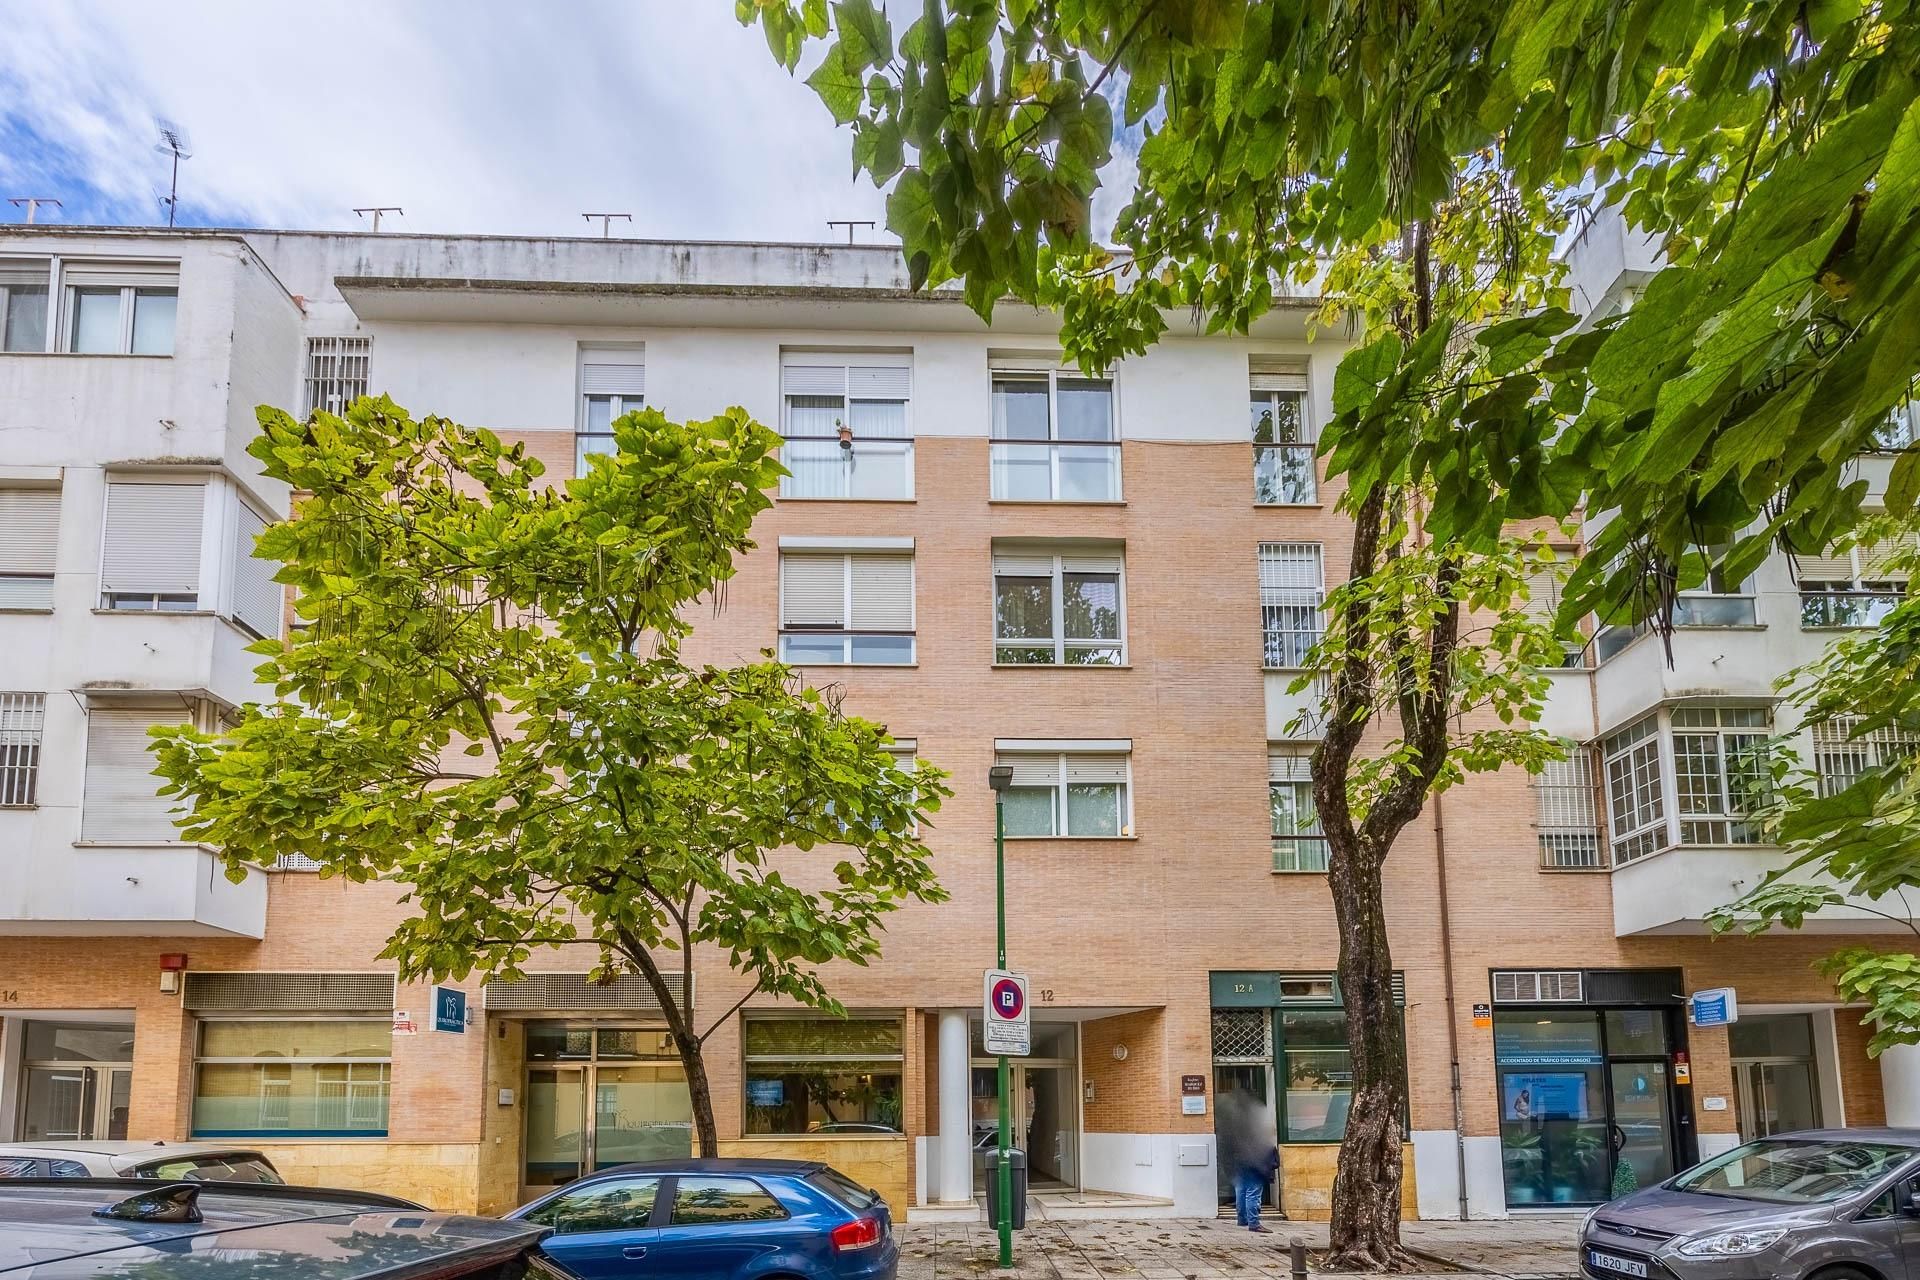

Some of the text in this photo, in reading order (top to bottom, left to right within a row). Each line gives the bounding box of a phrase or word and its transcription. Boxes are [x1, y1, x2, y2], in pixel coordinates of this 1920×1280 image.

[1235, 984, 1254, 993] 12 A
[2, 990, 18, 1002] 14
[1005, 993, 1012, 1004] P
[1041, 990, 1054, 1001] 12
[1599, 1256, 1643, 1275] 1620 JFV
